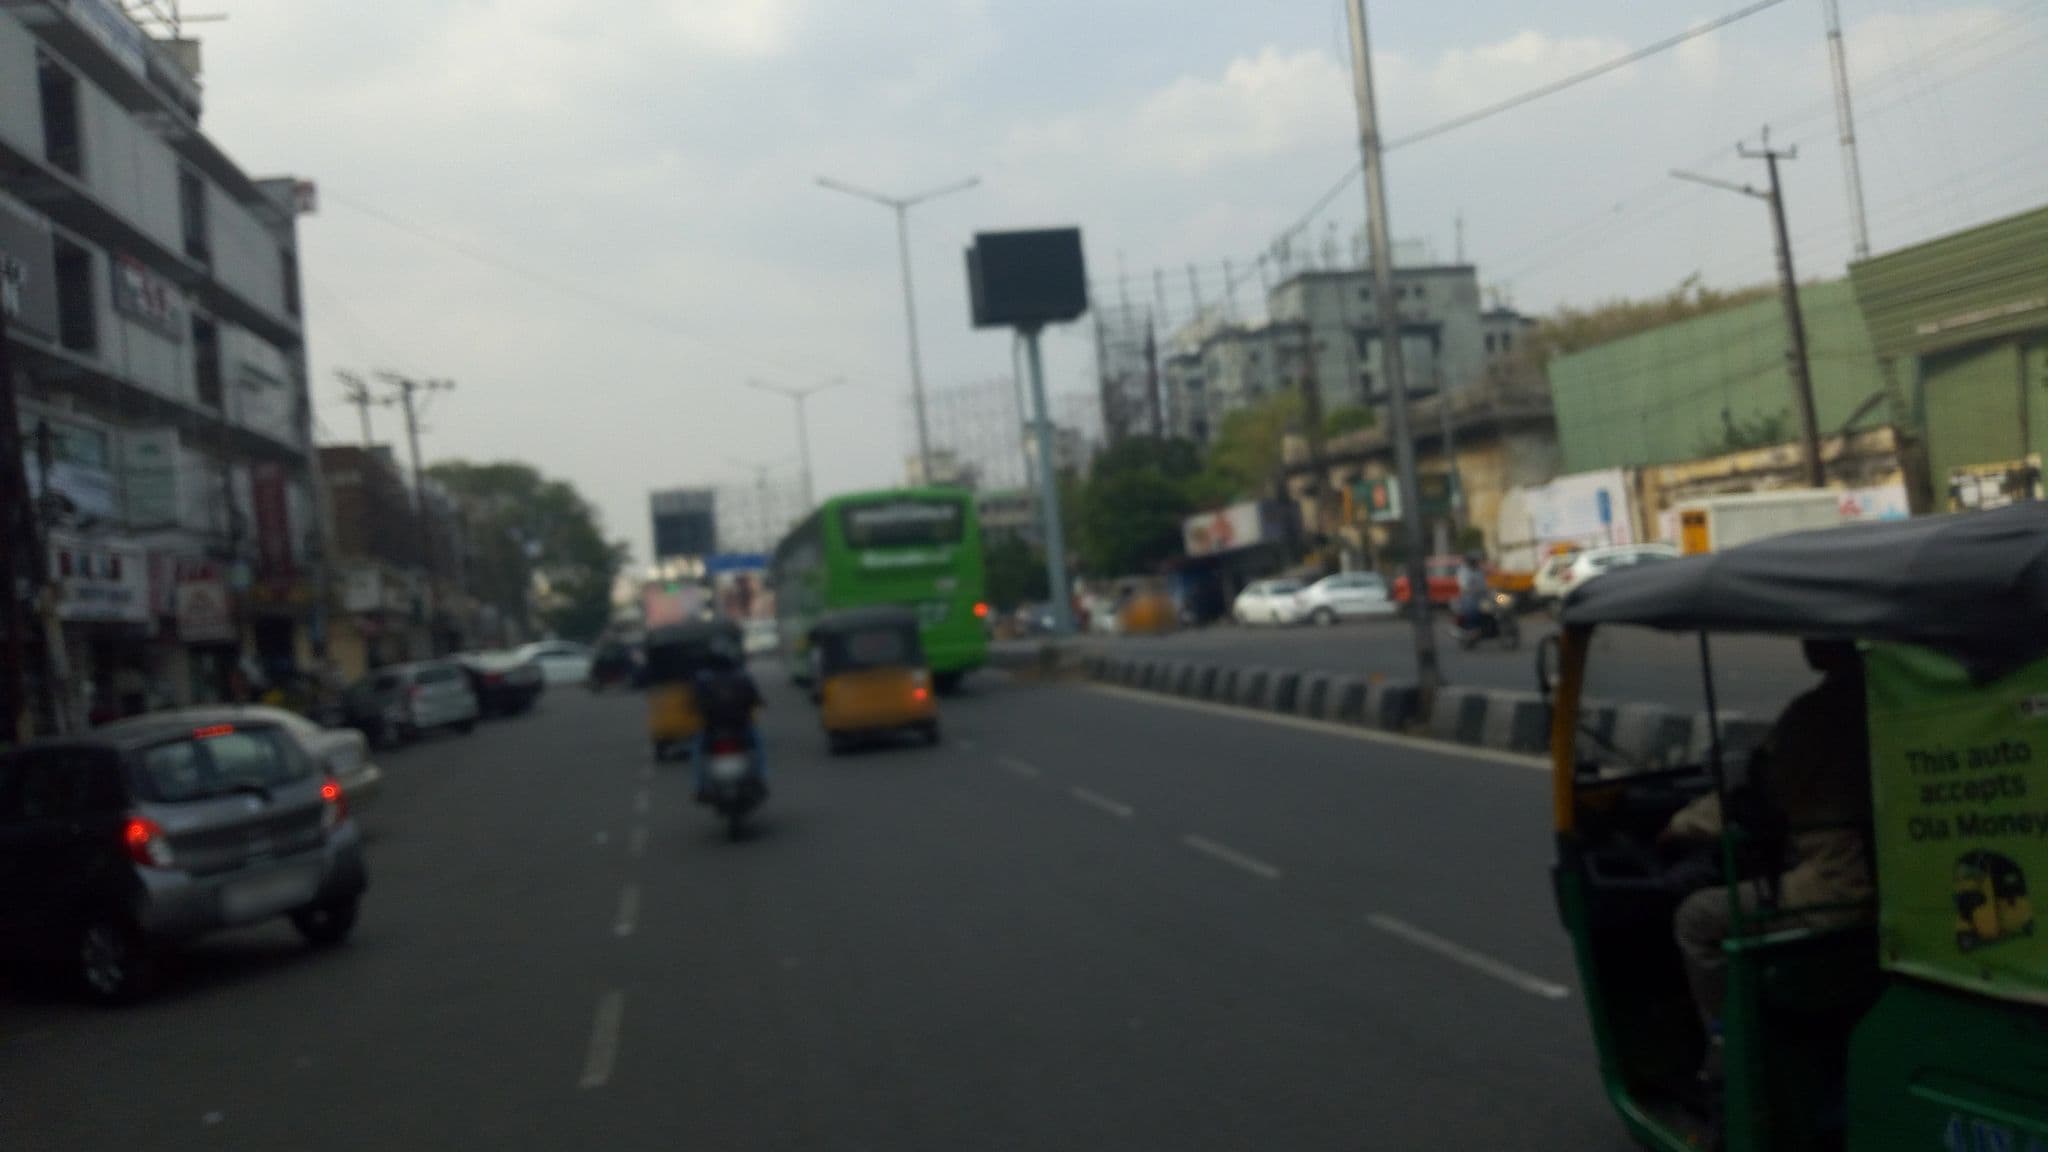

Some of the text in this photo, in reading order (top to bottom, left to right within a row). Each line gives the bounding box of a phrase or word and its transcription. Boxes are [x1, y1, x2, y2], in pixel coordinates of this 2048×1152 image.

[1904, 740, 2032, 774] This auto
[1920, 774, 2027, 805] accepts
[1907, 816, 1951, 841] Ola
